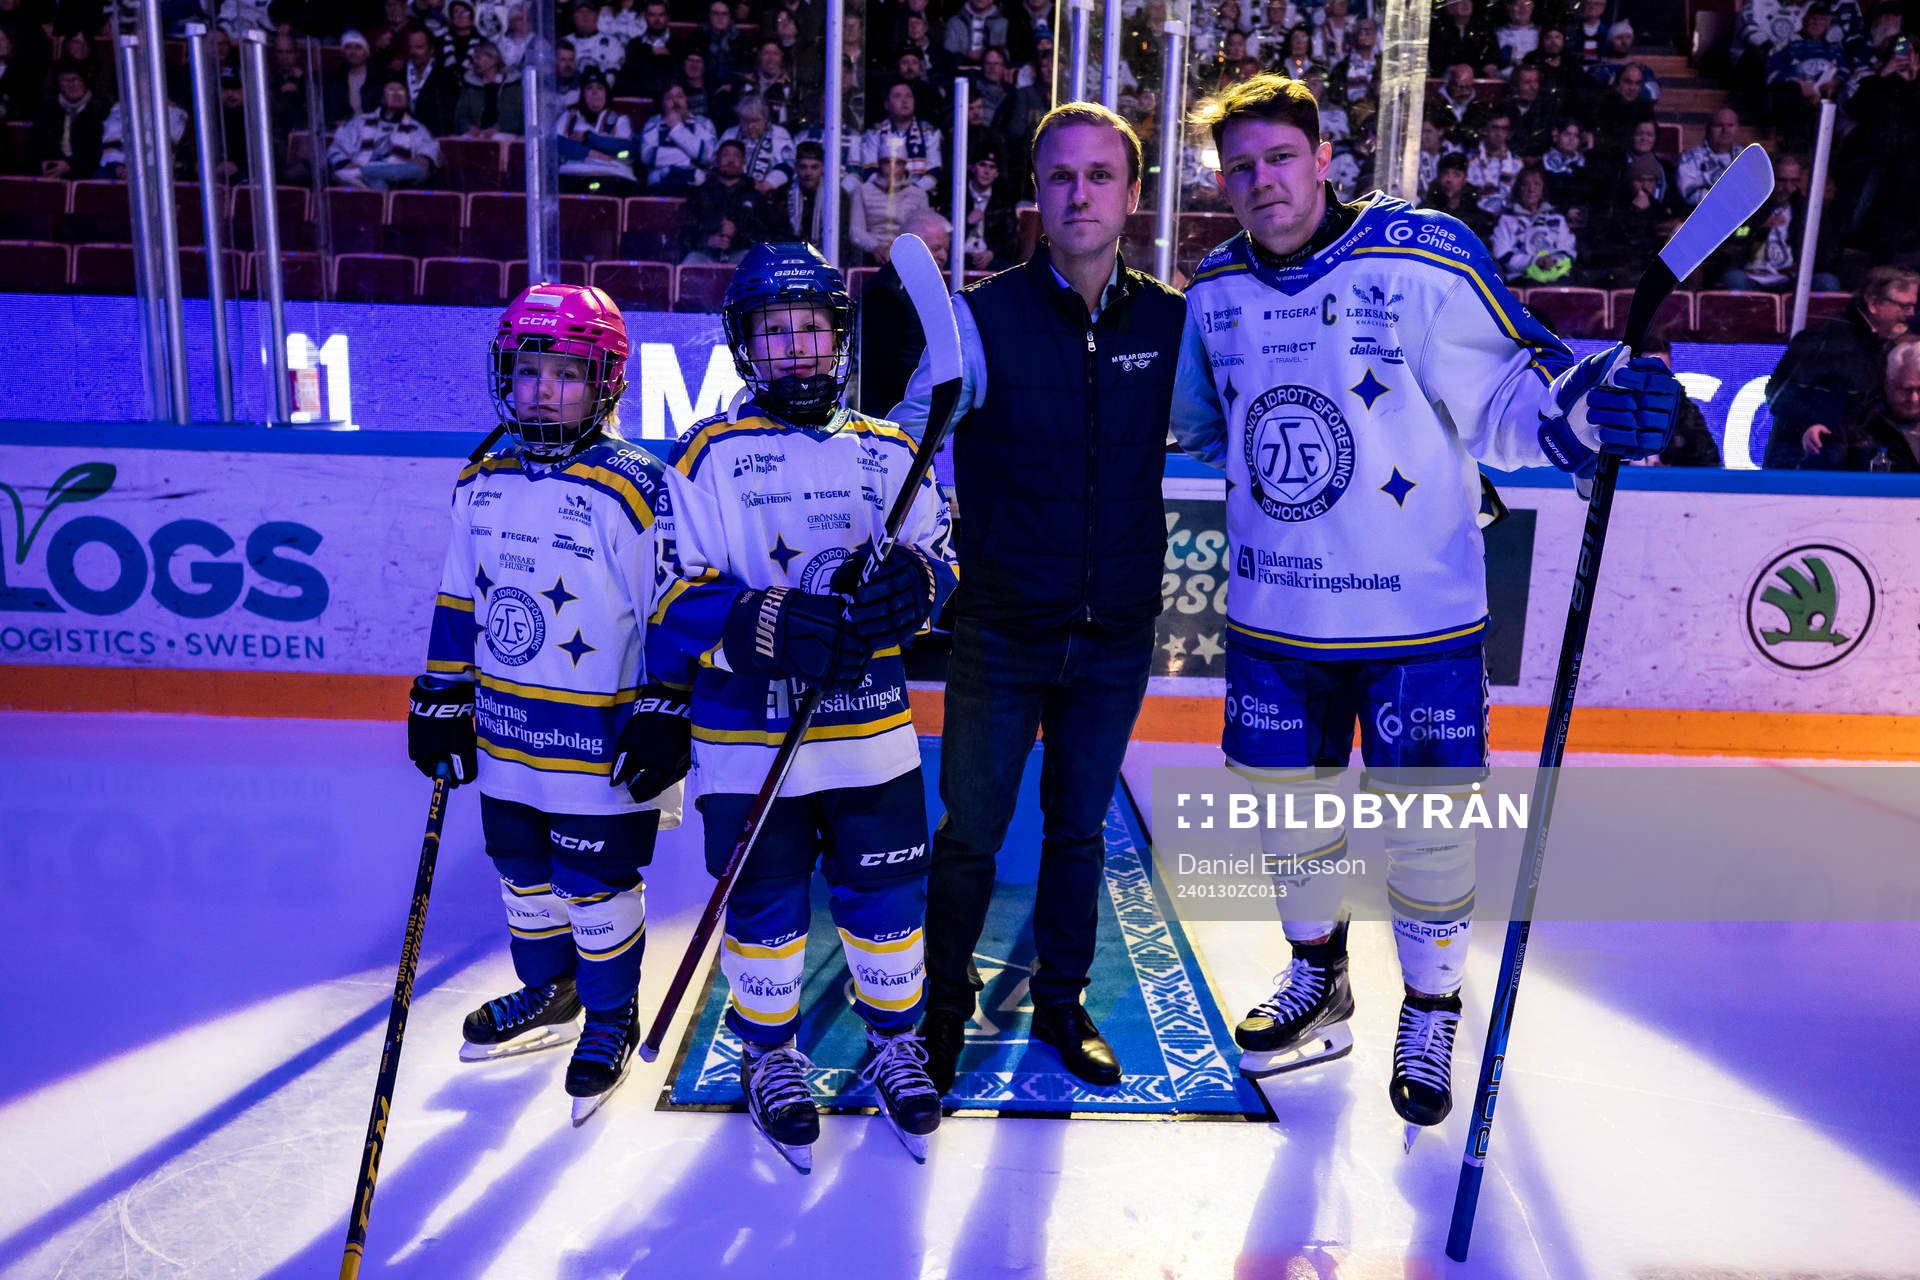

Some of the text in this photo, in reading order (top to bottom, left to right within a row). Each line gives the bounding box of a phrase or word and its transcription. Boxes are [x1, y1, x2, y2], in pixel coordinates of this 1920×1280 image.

[1334, 225, 1373, 257] TEGERA
[1420, 224, 1456, 241] Clas
[1416, 234, 1471, 259] Ohlson
[774, 268, 815, 277] BAUER
[1274, 308, 1317, 319] TEGERA
[1321, 292, 1338, 327] C
[518, 317, 558, 327] CCM
[1137, 351, 1159, 359] GROUP
[617, 448, 651, 466] clas
[606, 456, 655, 494] ohlson
[813, 491, 851, 499] TEGERA
[1261, 495, 1329, 521] ISHOCKEY
[506, 532, 539, 544] TEGERA
[551, 538, 596, 557] dalakraft
[1257, 549, 1323, 570] Dalarnas
[1257, 568, 1402, 594] Försäkringsbolag
[0, 626, 325, 660] OGISTICS SWEDEN
[478, 693, 528, 723] Dalarnas
[1241, 694, 1279, 714] Clas
[1241, 711, 1304, 731] Ohlson
[1410, 707, 1456, 723] Clas
[478, 711, 603, 755] Försäkringsbolag
[1410, 723, 1476, 741] Ohlson
[429, 777, 445, 820] CCM
[550, 829, 606, 853] CCM
[859, 843, 926, 868] CCM
[762, 930, 798, 946] CCM
[874, 926, 912, 942] CCM
[397, 913, 418, 983] TRE KRONOR
[402, 894, 430, 1009] TRE KRONOR
[747, 985, 763, 996] AB
[766, 985, 793, 997] KARL
[863, 976, 878, 985] AB
[880, 975, 910, 987] KARL
